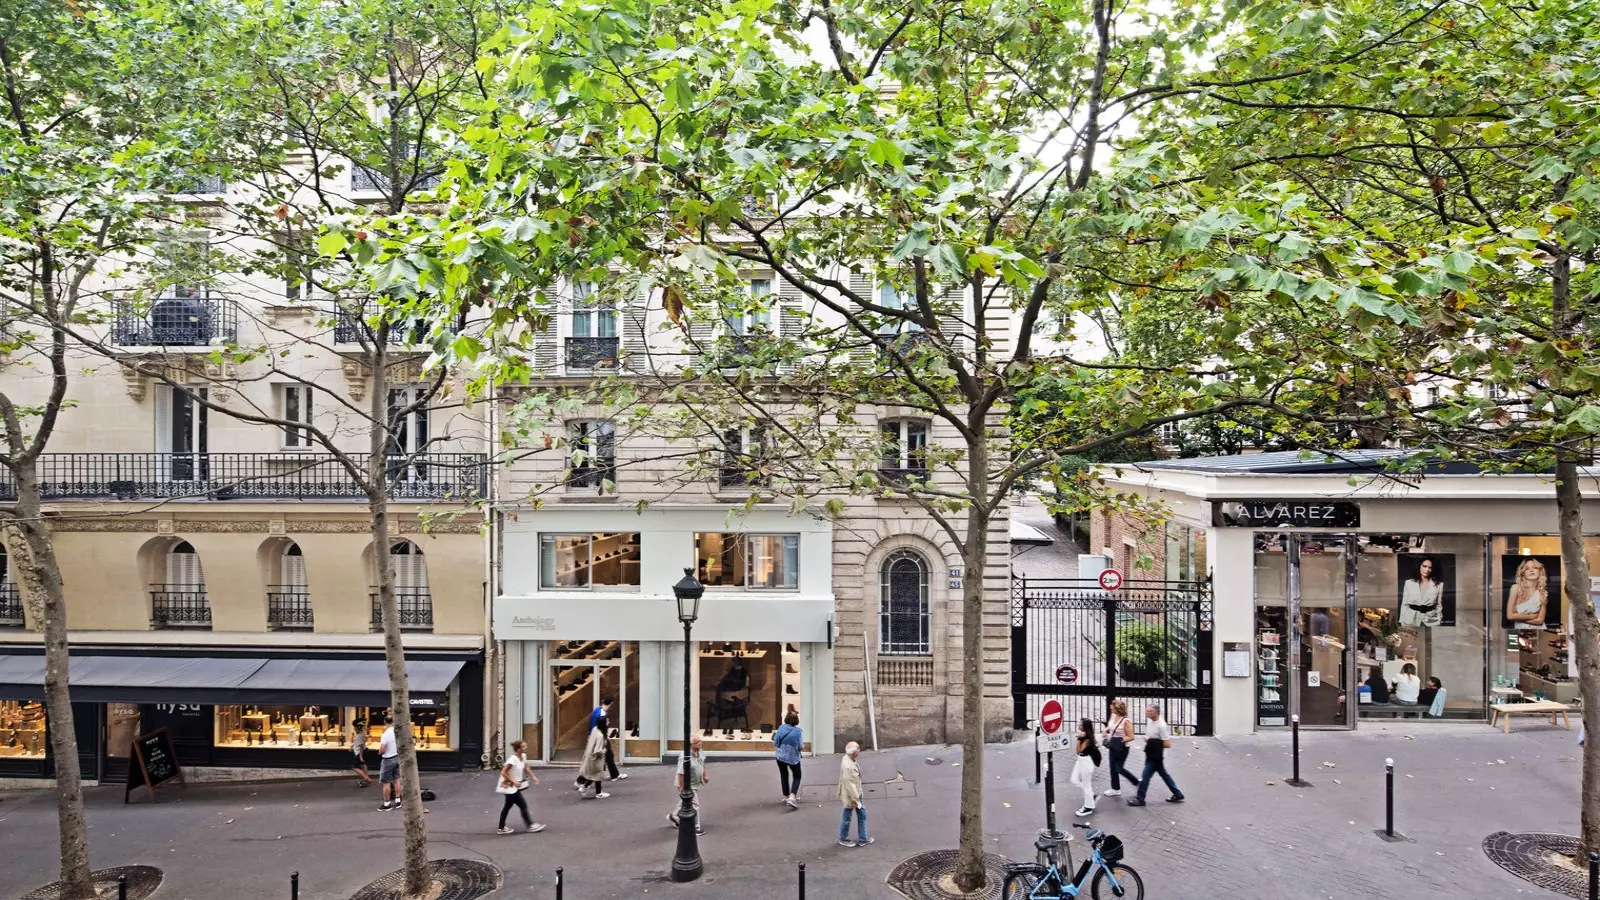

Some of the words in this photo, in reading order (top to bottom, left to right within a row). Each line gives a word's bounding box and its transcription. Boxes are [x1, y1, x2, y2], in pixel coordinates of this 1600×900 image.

[1237, 506, 1335, 519] ALVAREZ
[951, 569, 960, 577] 41
[511, 615, 554, 625] Anthology
[114, 707, 134, 716] nysa
[157, 703, 200, 714] nysa
